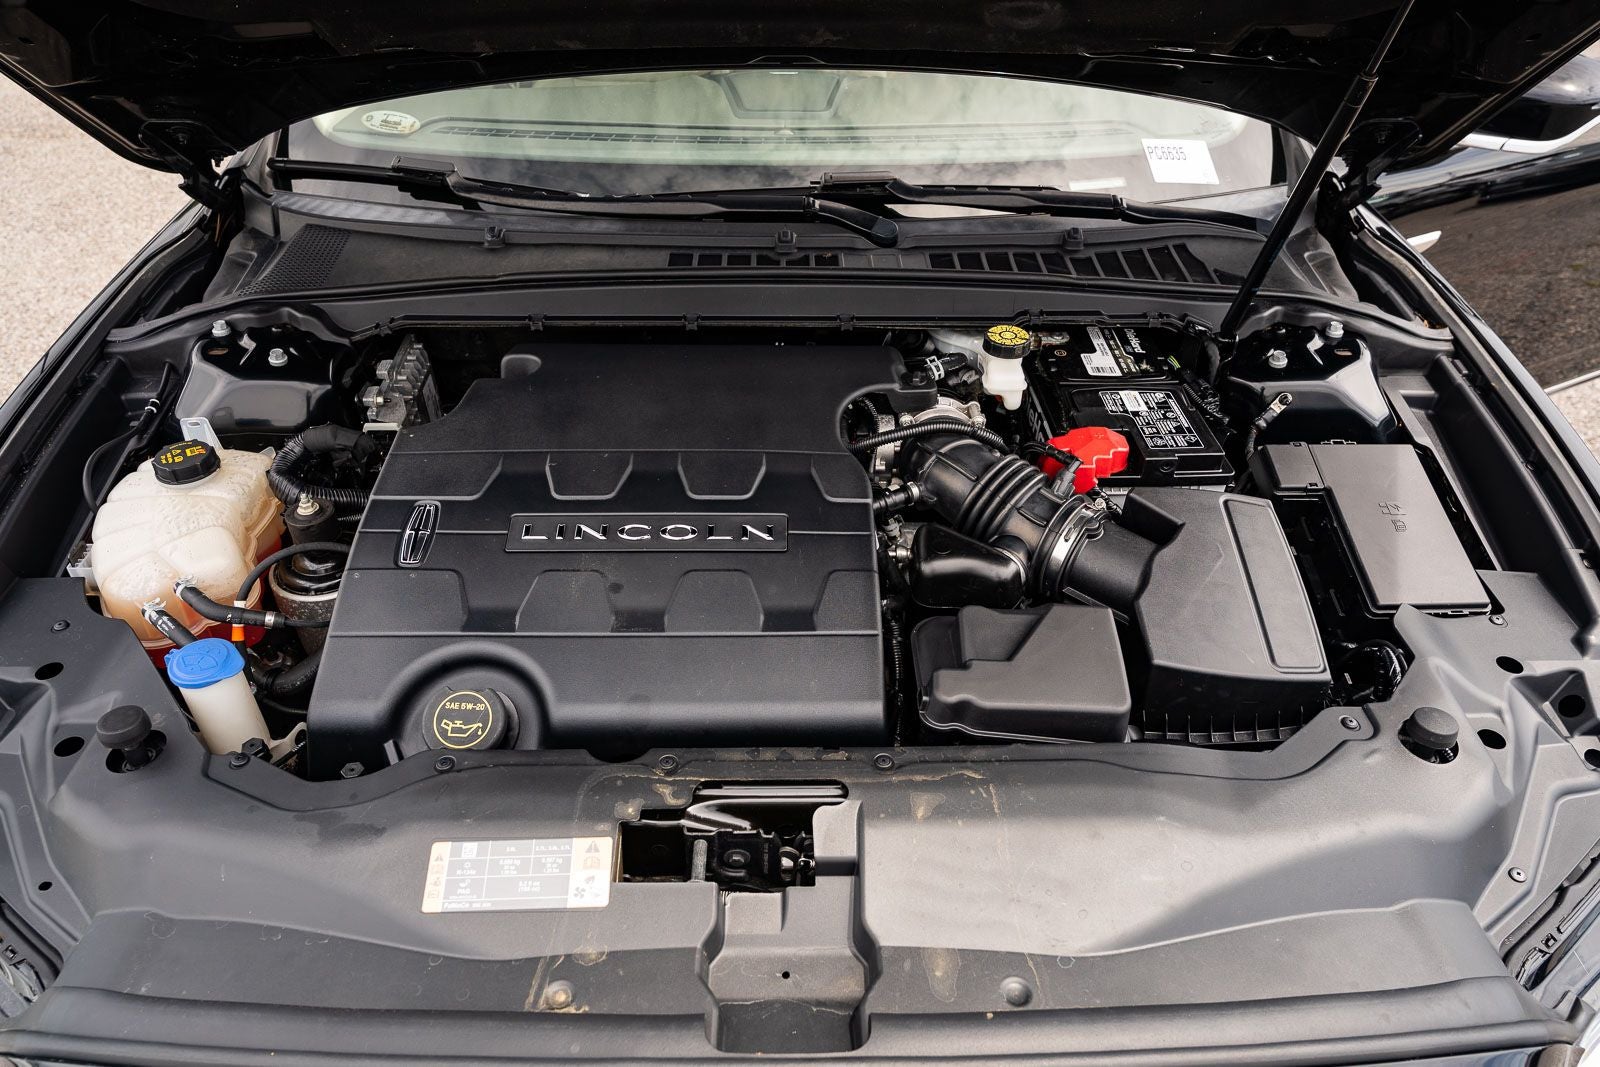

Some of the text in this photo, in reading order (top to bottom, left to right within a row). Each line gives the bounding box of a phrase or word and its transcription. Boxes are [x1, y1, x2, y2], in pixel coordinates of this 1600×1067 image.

[1146, 146, 1187, 160] PC6635
[1124, 328, 1146, 354] DieHard
[521, 523, 775, 542] LINCOLN
[461, 702, 485, 710] 5W-20
